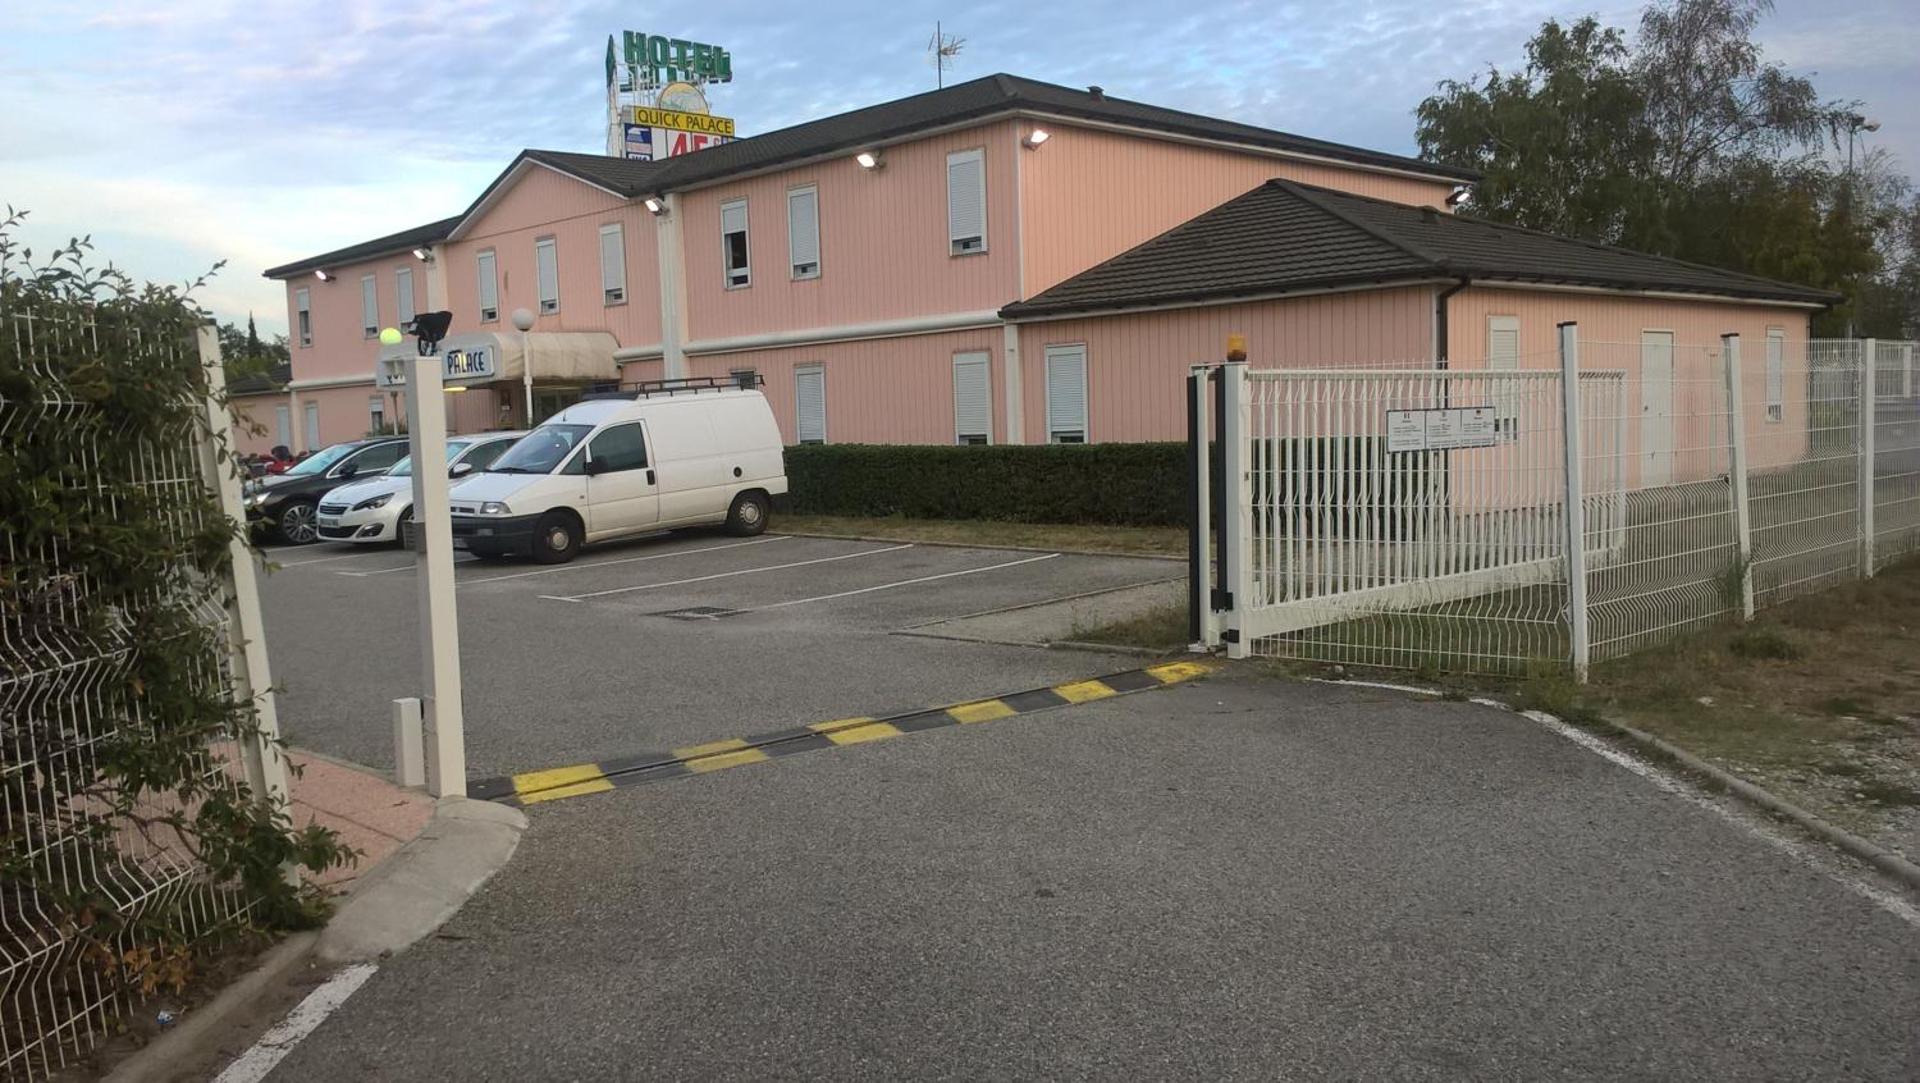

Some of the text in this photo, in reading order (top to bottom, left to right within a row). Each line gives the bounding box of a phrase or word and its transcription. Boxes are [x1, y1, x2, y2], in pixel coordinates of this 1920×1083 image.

[623, 30, 731, 79] HOTEL
[637, 109, 732, 134] QUICK PALACE
[447, 351, 485, 375] PALACE
